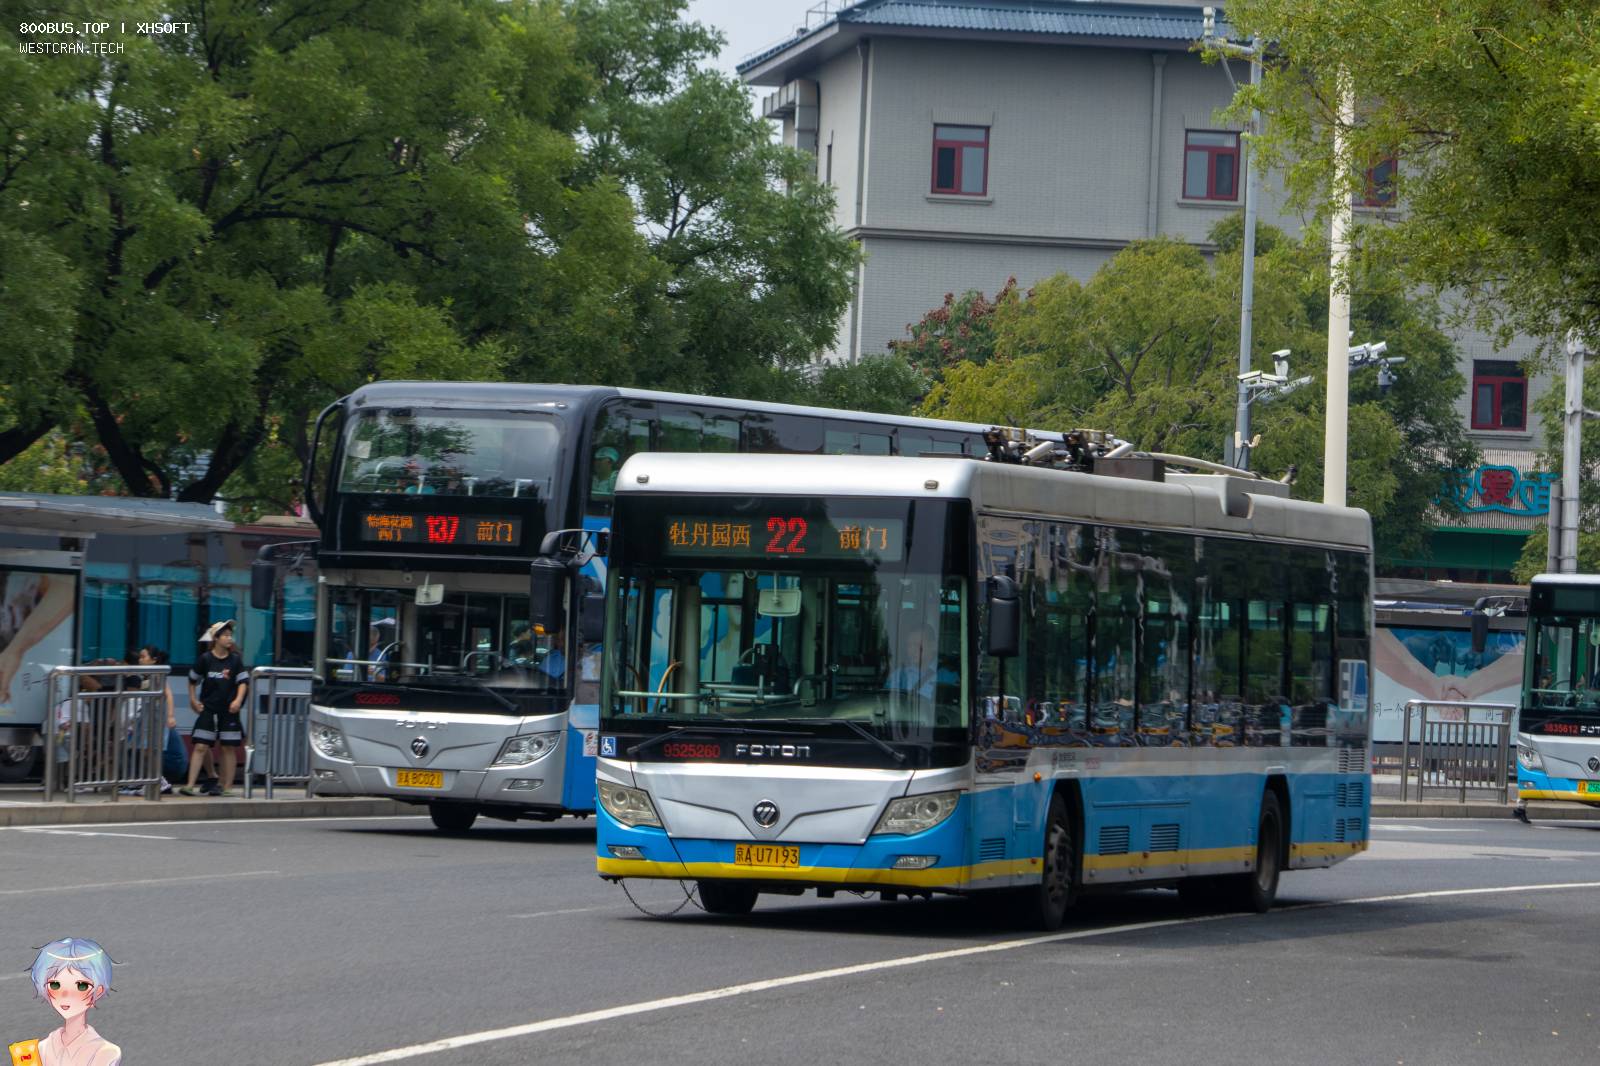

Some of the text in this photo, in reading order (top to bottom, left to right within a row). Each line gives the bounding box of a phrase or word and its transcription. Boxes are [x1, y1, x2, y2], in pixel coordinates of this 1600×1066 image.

[425, 515, 460, 543] 137
[476, 521, 513, 543] 前门
[669, 517, 888, 553] 牡丹园西 22 前门
[664, 743, 811, 758] 9525260 FOTON
